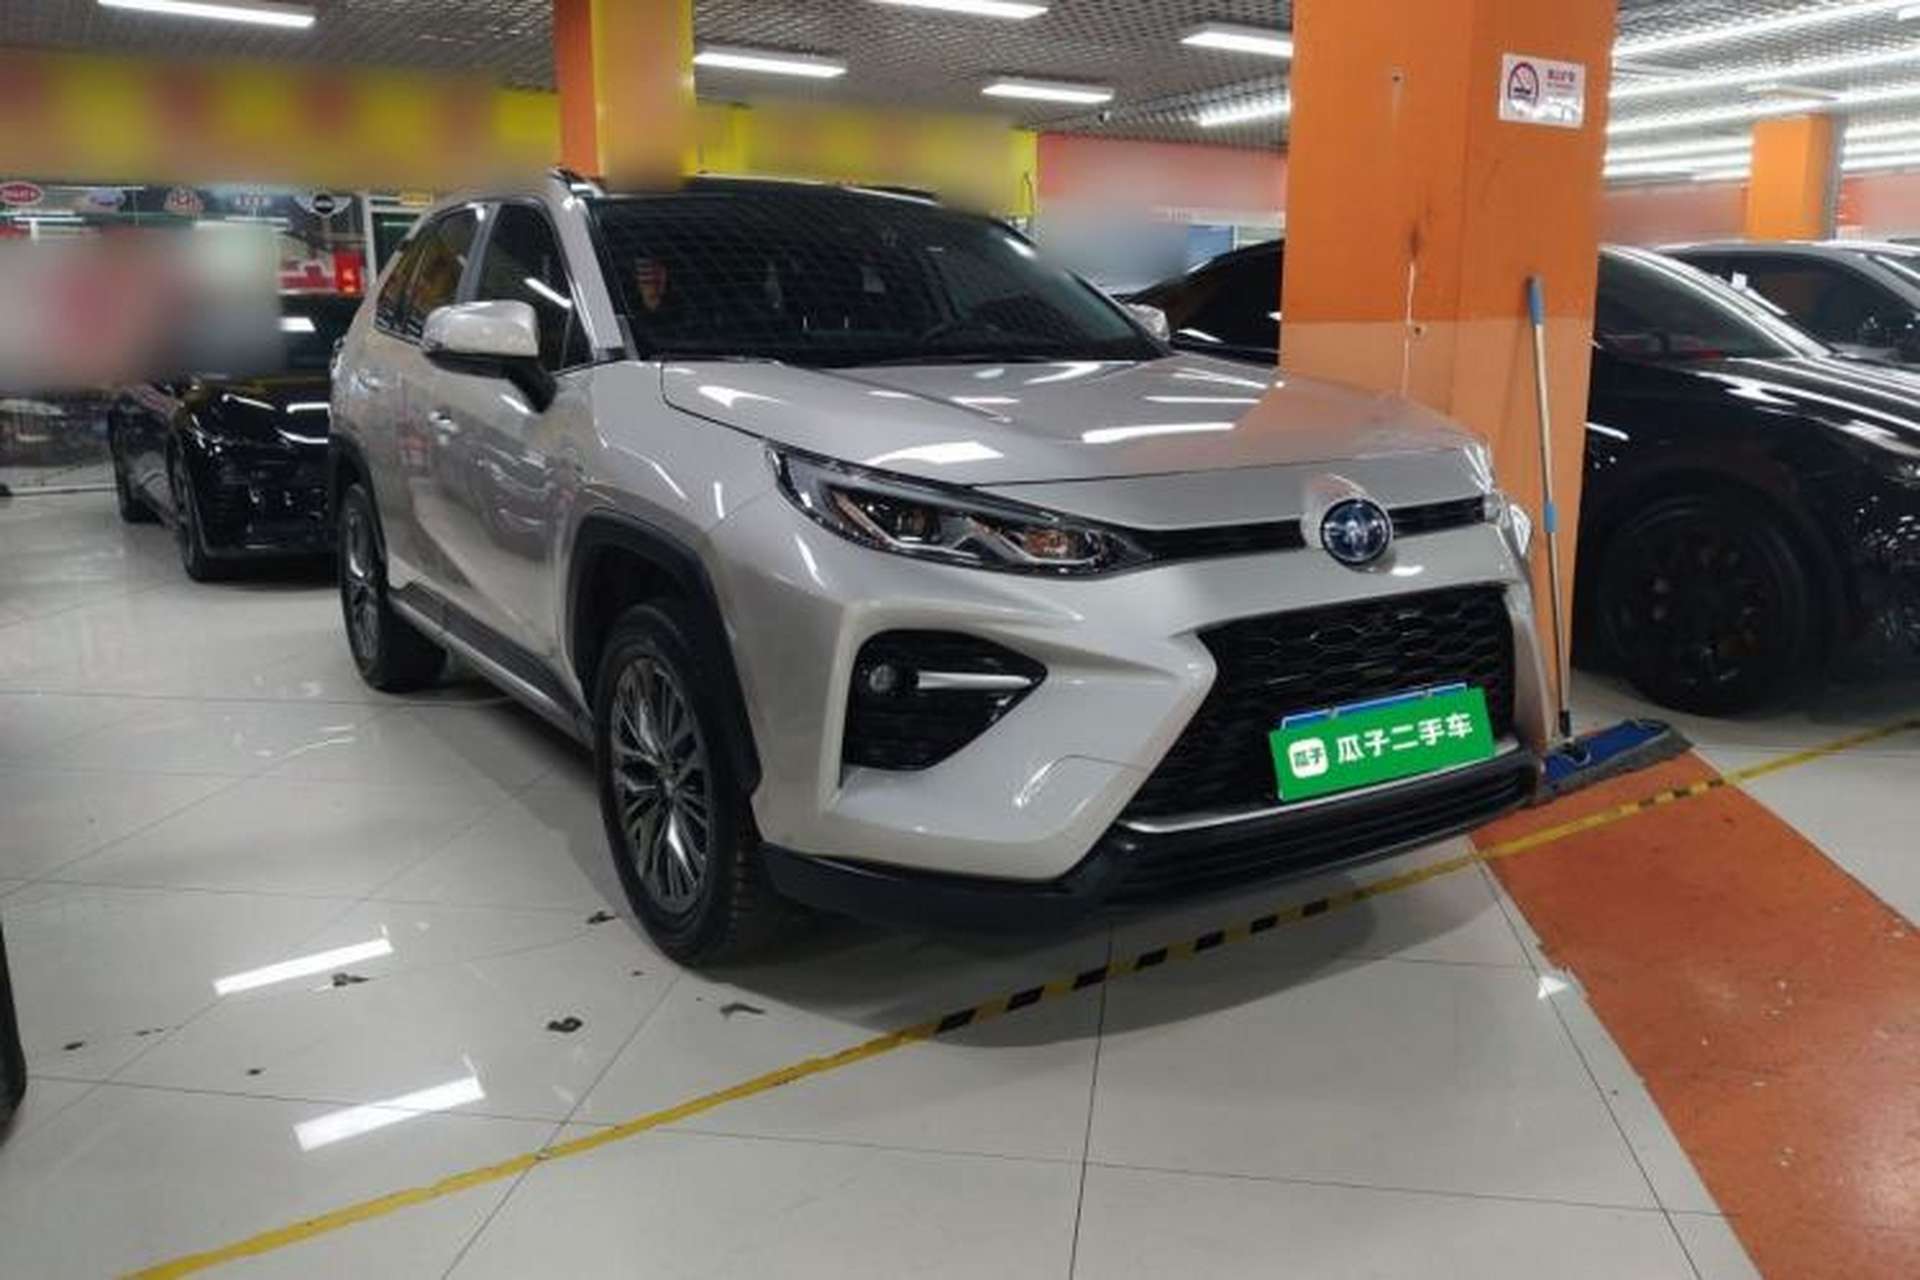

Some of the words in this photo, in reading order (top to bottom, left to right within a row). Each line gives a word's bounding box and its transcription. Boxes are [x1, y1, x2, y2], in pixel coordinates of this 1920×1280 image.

[1336, 713, 1473, 764] 瓜子二手车
